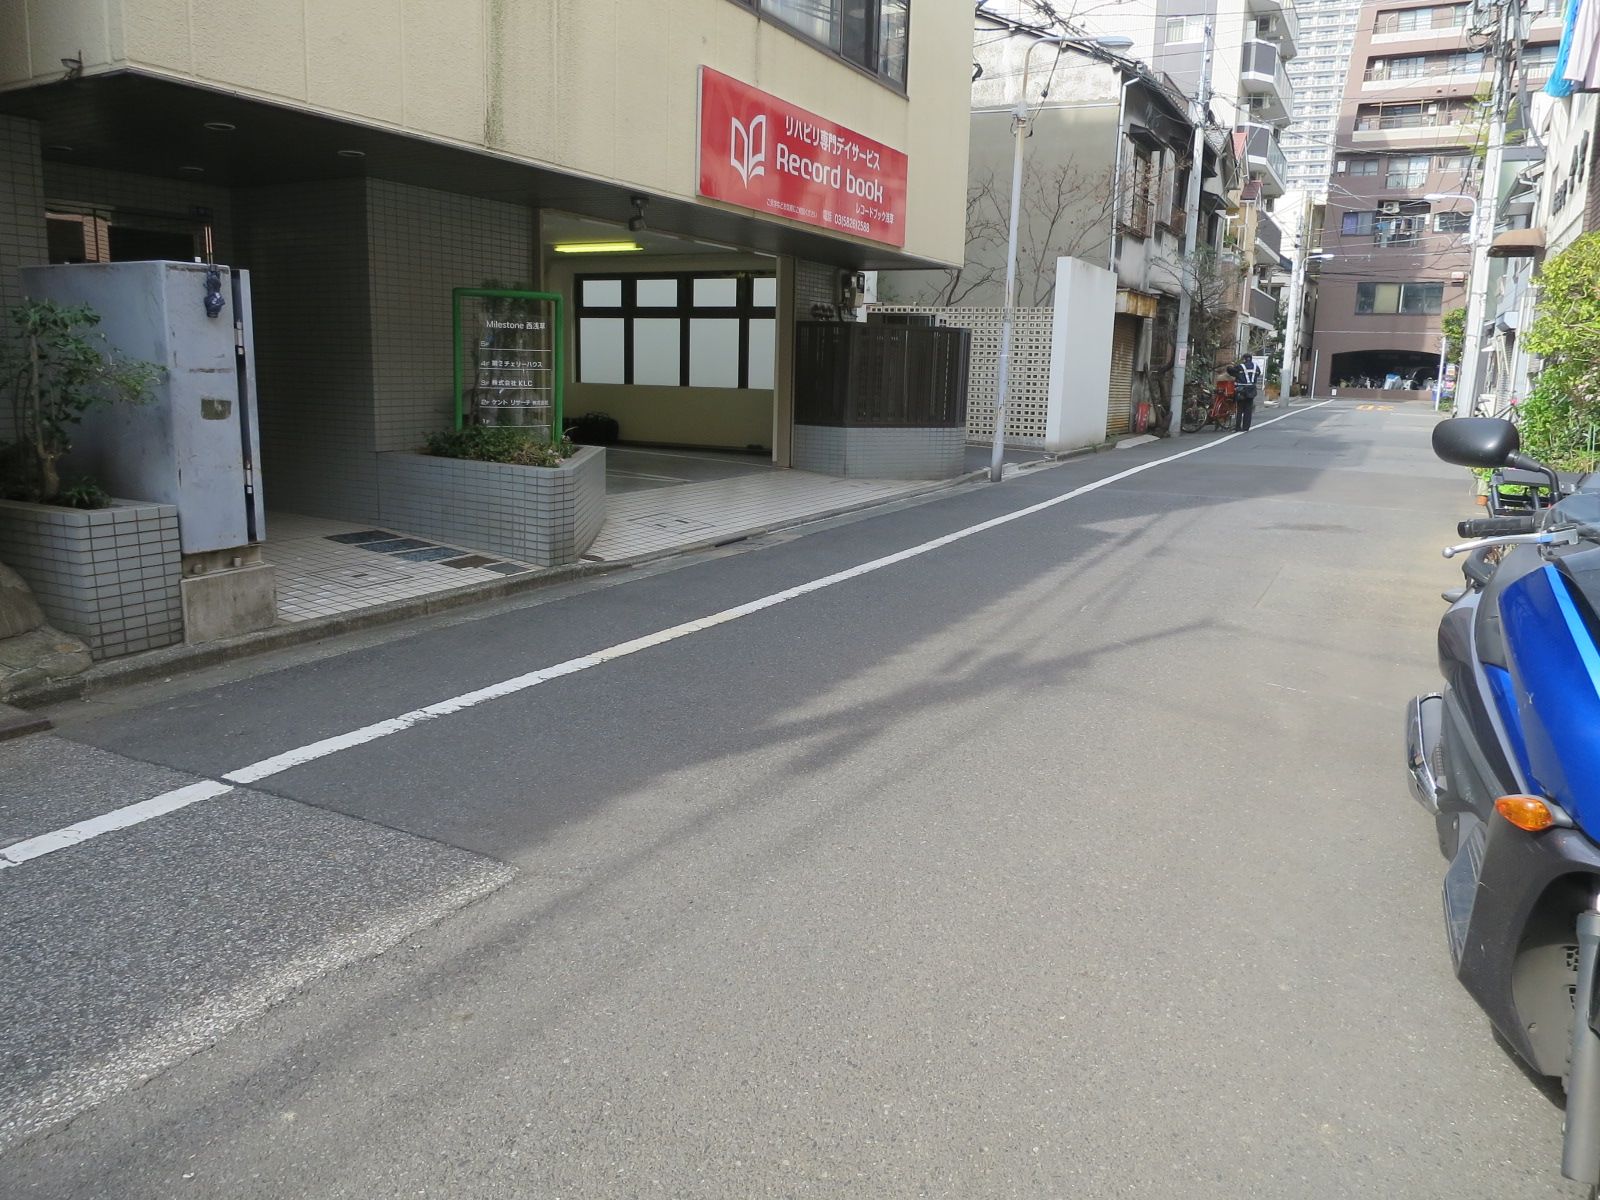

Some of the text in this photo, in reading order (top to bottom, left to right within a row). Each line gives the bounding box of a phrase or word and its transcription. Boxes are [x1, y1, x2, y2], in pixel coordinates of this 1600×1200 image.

[786, 116, 880, 170] リハビリ専門デイサービス
[776, 143, 884, 204] Record book
[486, 320, 525, 330] Milestone
[491, 379, 517, 387] 株式会社
